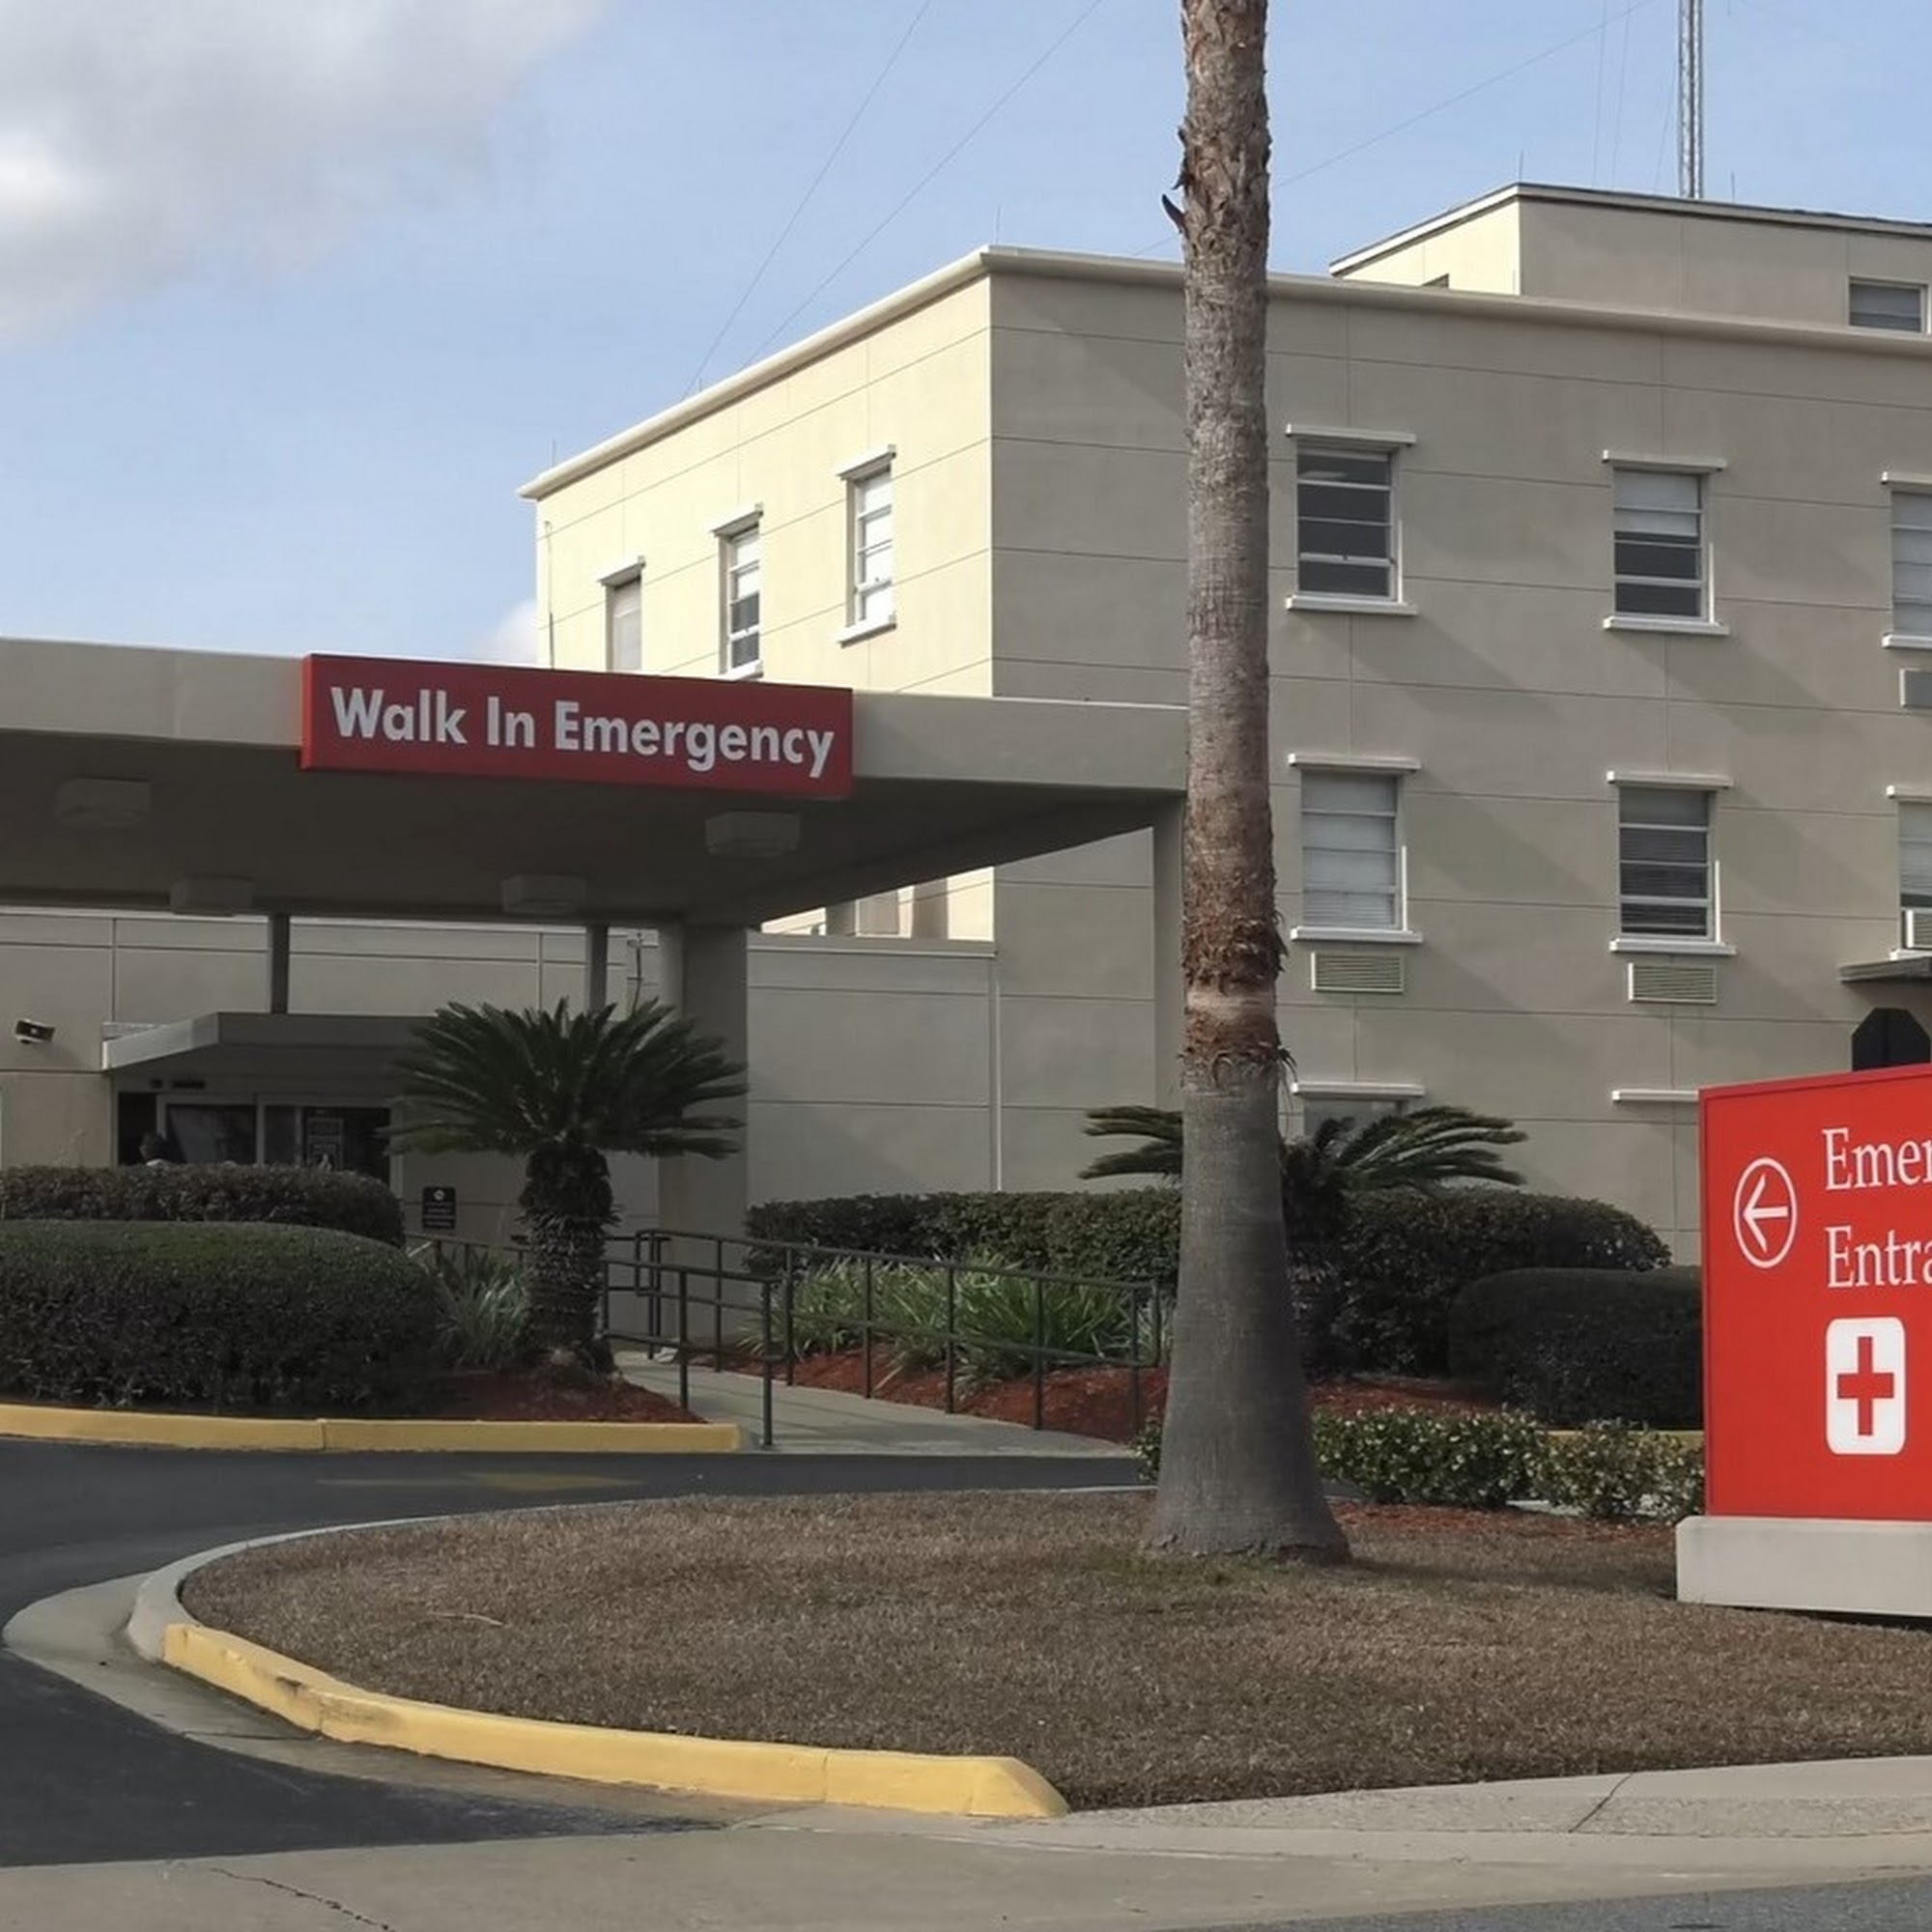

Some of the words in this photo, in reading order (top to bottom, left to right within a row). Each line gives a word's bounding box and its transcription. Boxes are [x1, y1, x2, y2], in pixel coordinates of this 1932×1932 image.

[330, 687, 468, 744] Walk
[487, 696, 535, 748] In
[554, 700, 835, 779] Emergency
